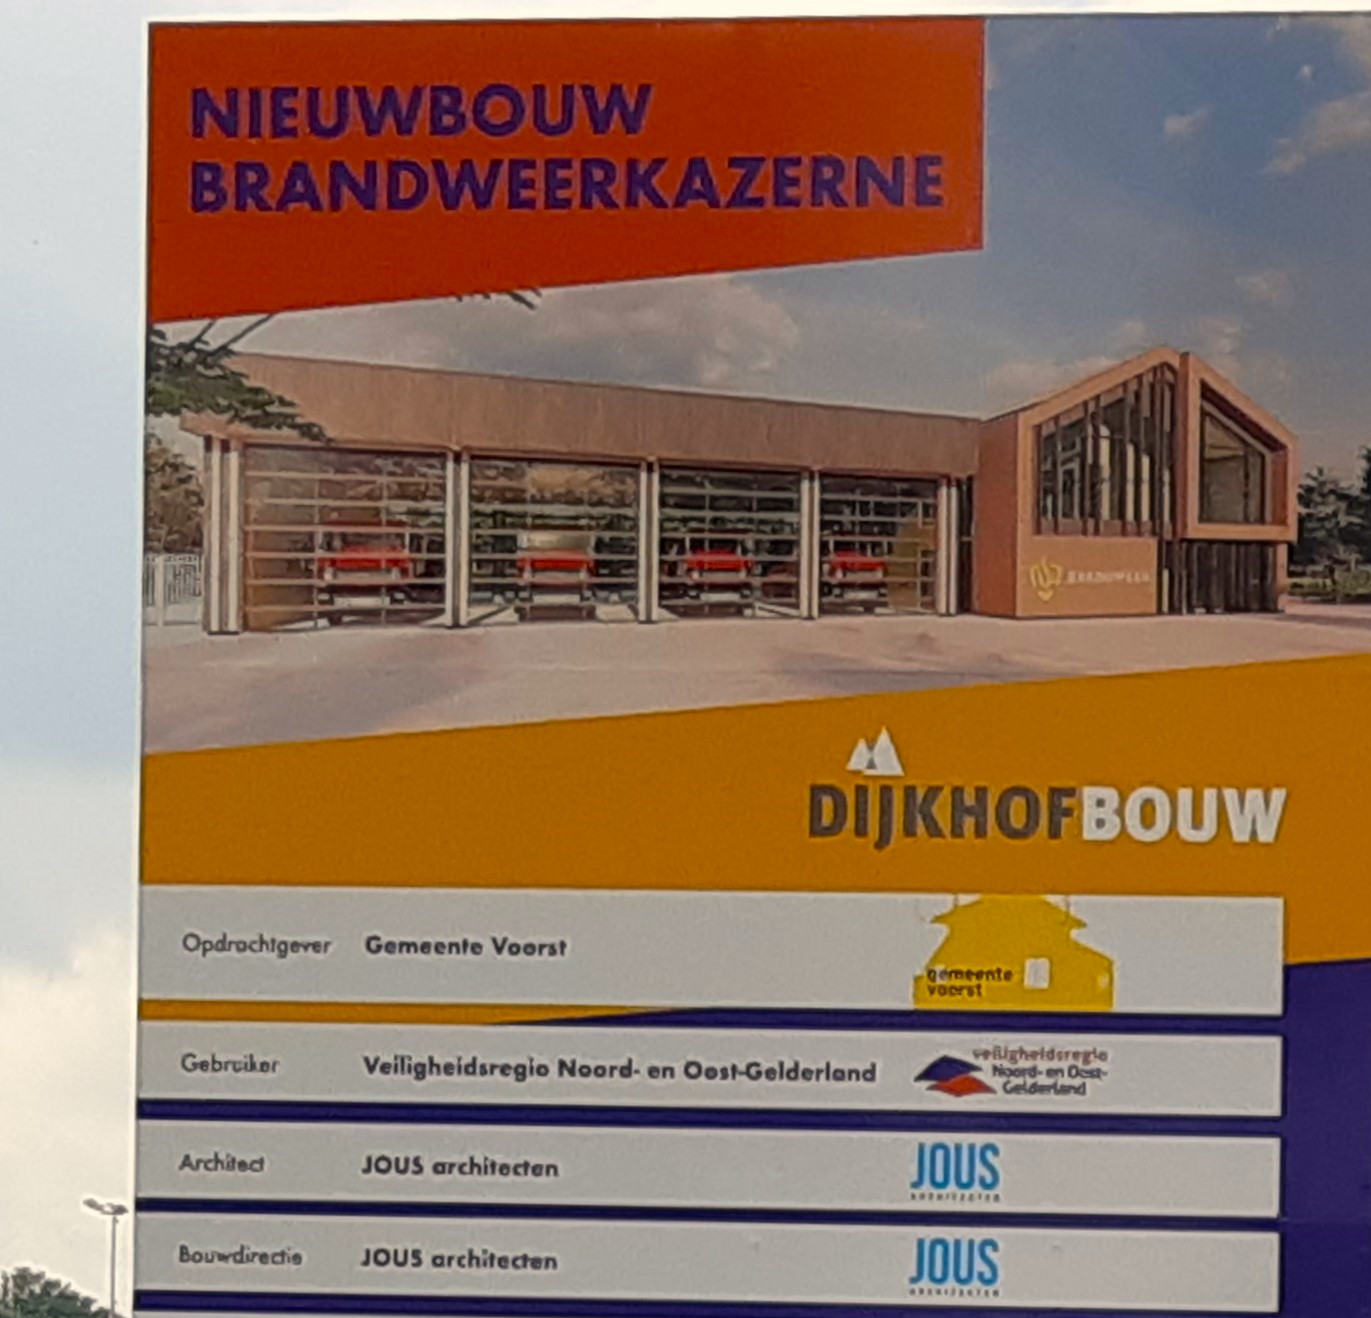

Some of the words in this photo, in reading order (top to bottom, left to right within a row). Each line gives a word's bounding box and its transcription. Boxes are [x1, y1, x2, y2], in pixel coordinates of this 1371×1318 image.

[191, 82, 653, 140] NIEUWBOUW
[191, 150, 942, 213] BRANDWEERKAZERNE
[809, 785, 1287, 849] DIJKHOFBOUW
[182, 932, 331, 959] Opdrachtgever
[365, 935, 483, 956] Gemeente
[491, 937, 567, 957] Voorst
[926, 967, 1013, 984] gemeente
[180, 1052, 278, 1073] Gebruiker
[363, 1054, 550, 1083] Veiligheidsregio
[558, 1058, 640, 1079] Noord-
[647, 1065, 675, 1079] en
[683, 1060, 876, 1082] Oost-Gelderland
[178, 1151, 265, 1173] Architect
[361, 1154, 424, 1175] JOUS
[432, 1156, 559, 1177] architecten
[910, 1142, 1000, 1190] JOUS
[178, 1244, 303, 1266] Bouwdirectie
[361, 1248, 423, 1268] JOUS
[431, 1248, 558, 1270] architecten
[909, 1237, 999, 1286] JOUS
